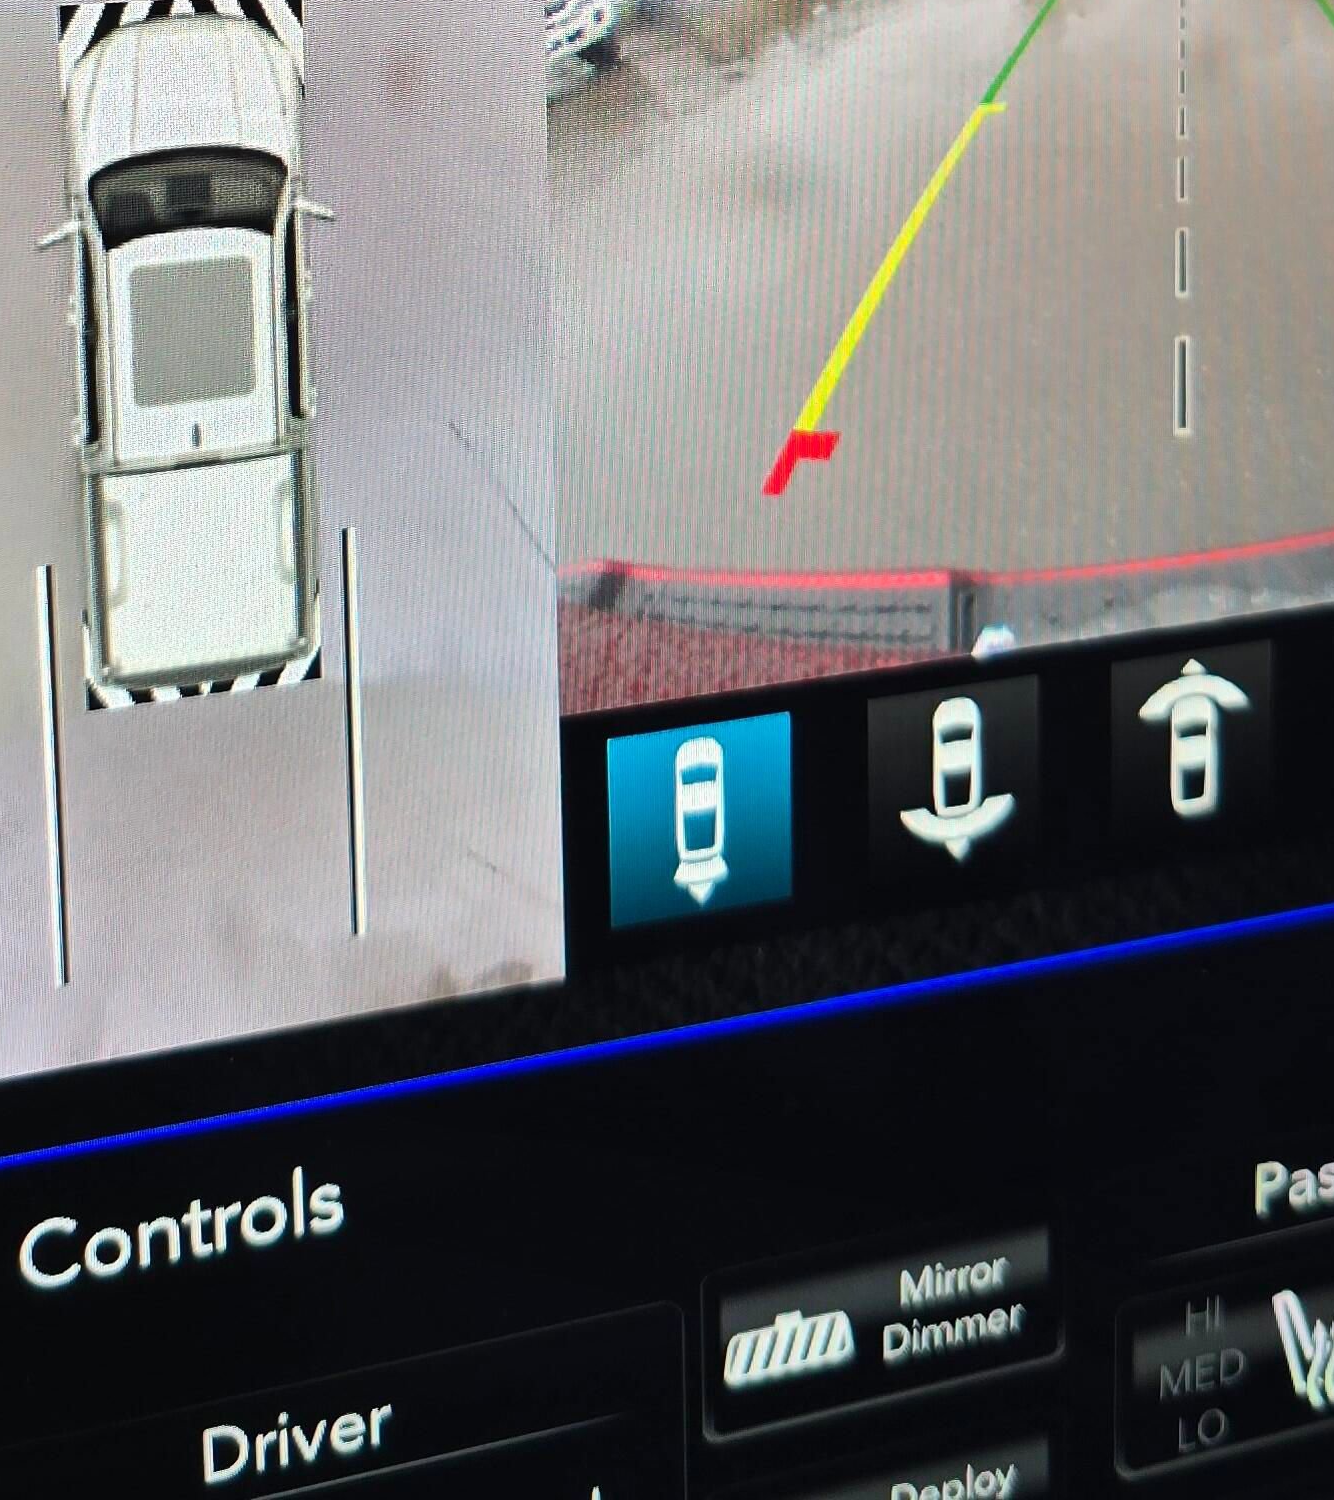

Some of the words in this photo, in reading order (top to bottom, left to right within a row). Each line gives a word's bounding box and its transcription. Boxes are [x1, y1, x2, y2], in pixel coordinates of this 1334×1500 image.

[19, 1165, 345, 1289] Controls
[899, 1254, 1011, 1307] Mirror
[882, 1299, 1026, 1363] Dimmer
[1185, 1296, 1222, 1337] HI
[1160, 1348, 1243, 1397] MED
[202, 1402, 394, 1484] Driver
[1179, 1410, 1227, 1453] LO
